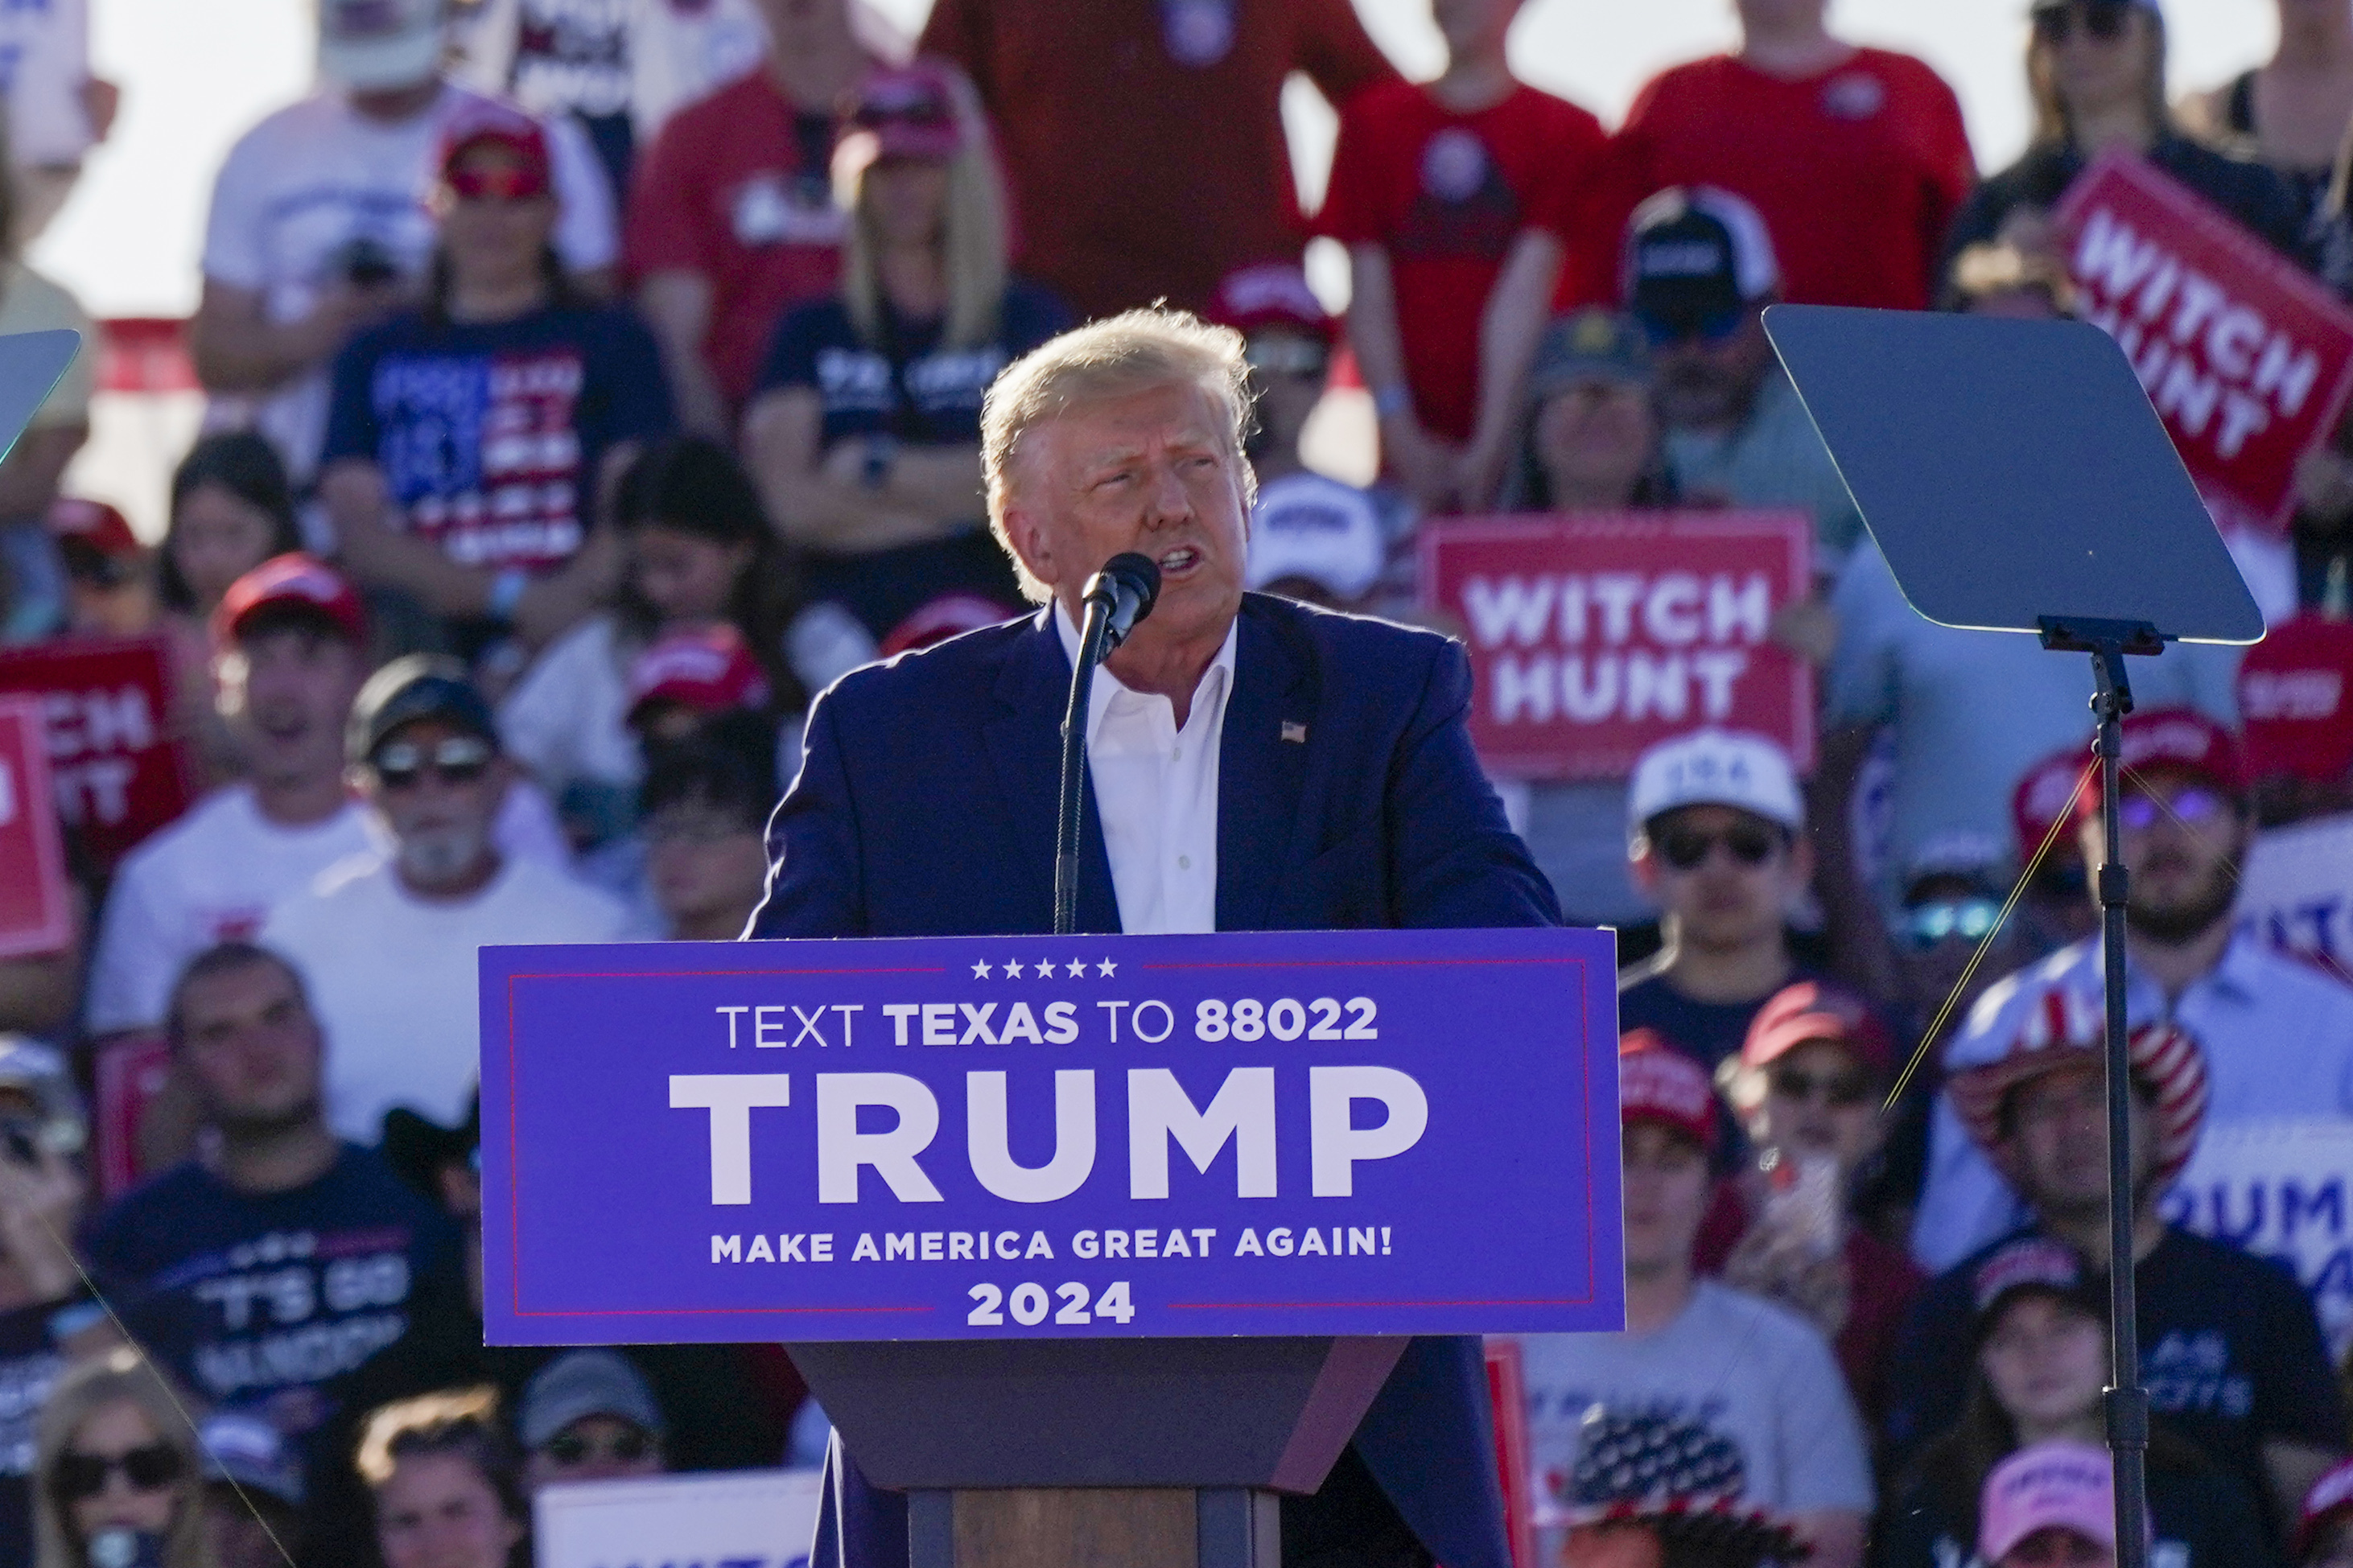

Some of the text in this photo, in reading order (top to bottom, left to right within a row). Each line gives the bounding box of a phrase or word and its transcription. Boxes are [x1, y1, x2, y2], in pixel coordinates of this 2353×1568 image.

[2076, 208, 2319, 418] WITCH
[1465, 573, 1770, 646] WITCH
[1494, 651, 1748, 722] HUNT
[715, 997, 1378, 1048] TEXT TEXAS TO 88022
[669, 1066, 1428, 1205] TRUMP
[711, 1226, 1391, 1263] MAKE AMERICA GREAT AGAIN!
[967, 1281, 1135, 1326] 2024
